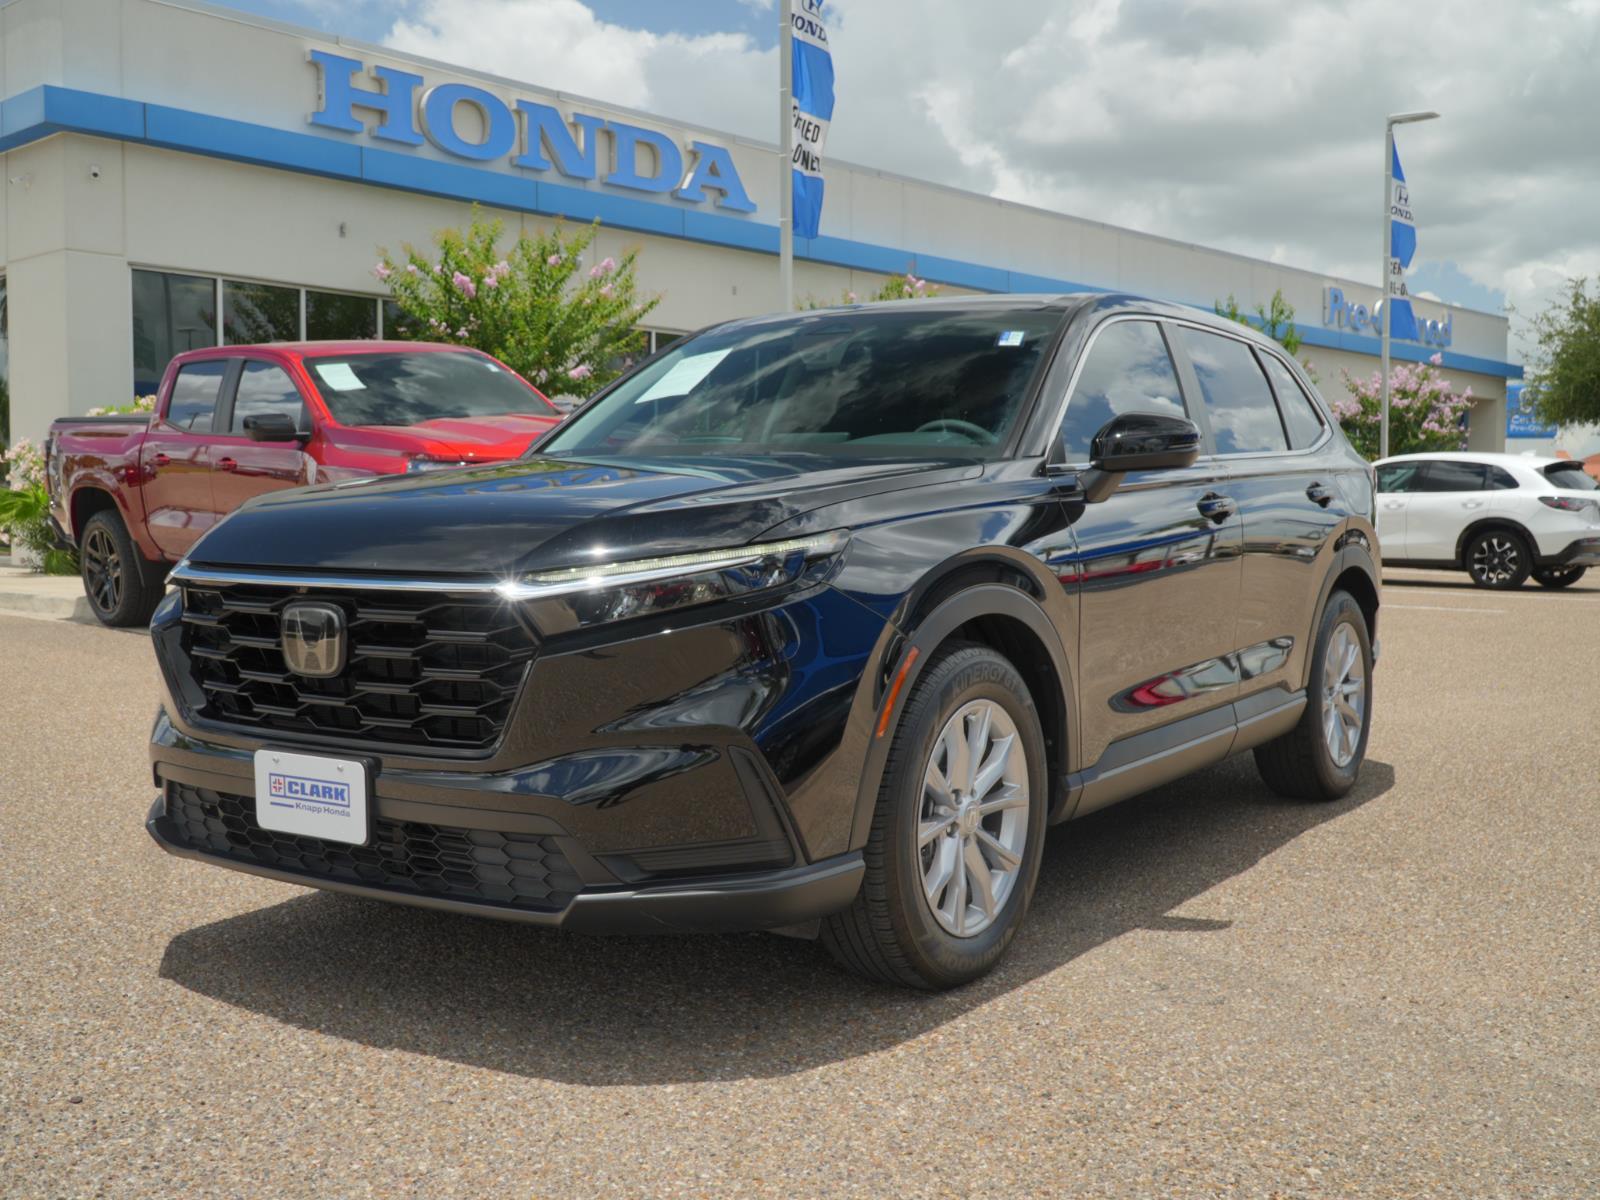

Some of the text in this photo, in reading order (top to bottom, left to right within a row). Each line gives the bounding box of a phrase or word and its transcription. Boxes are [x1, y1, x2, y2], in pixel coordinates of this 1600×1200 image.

[306, 49, 757, 213] HONDA
[287, 781, 346, 801] CLARK
[295, 802, 350, 817] Knapp Honda
